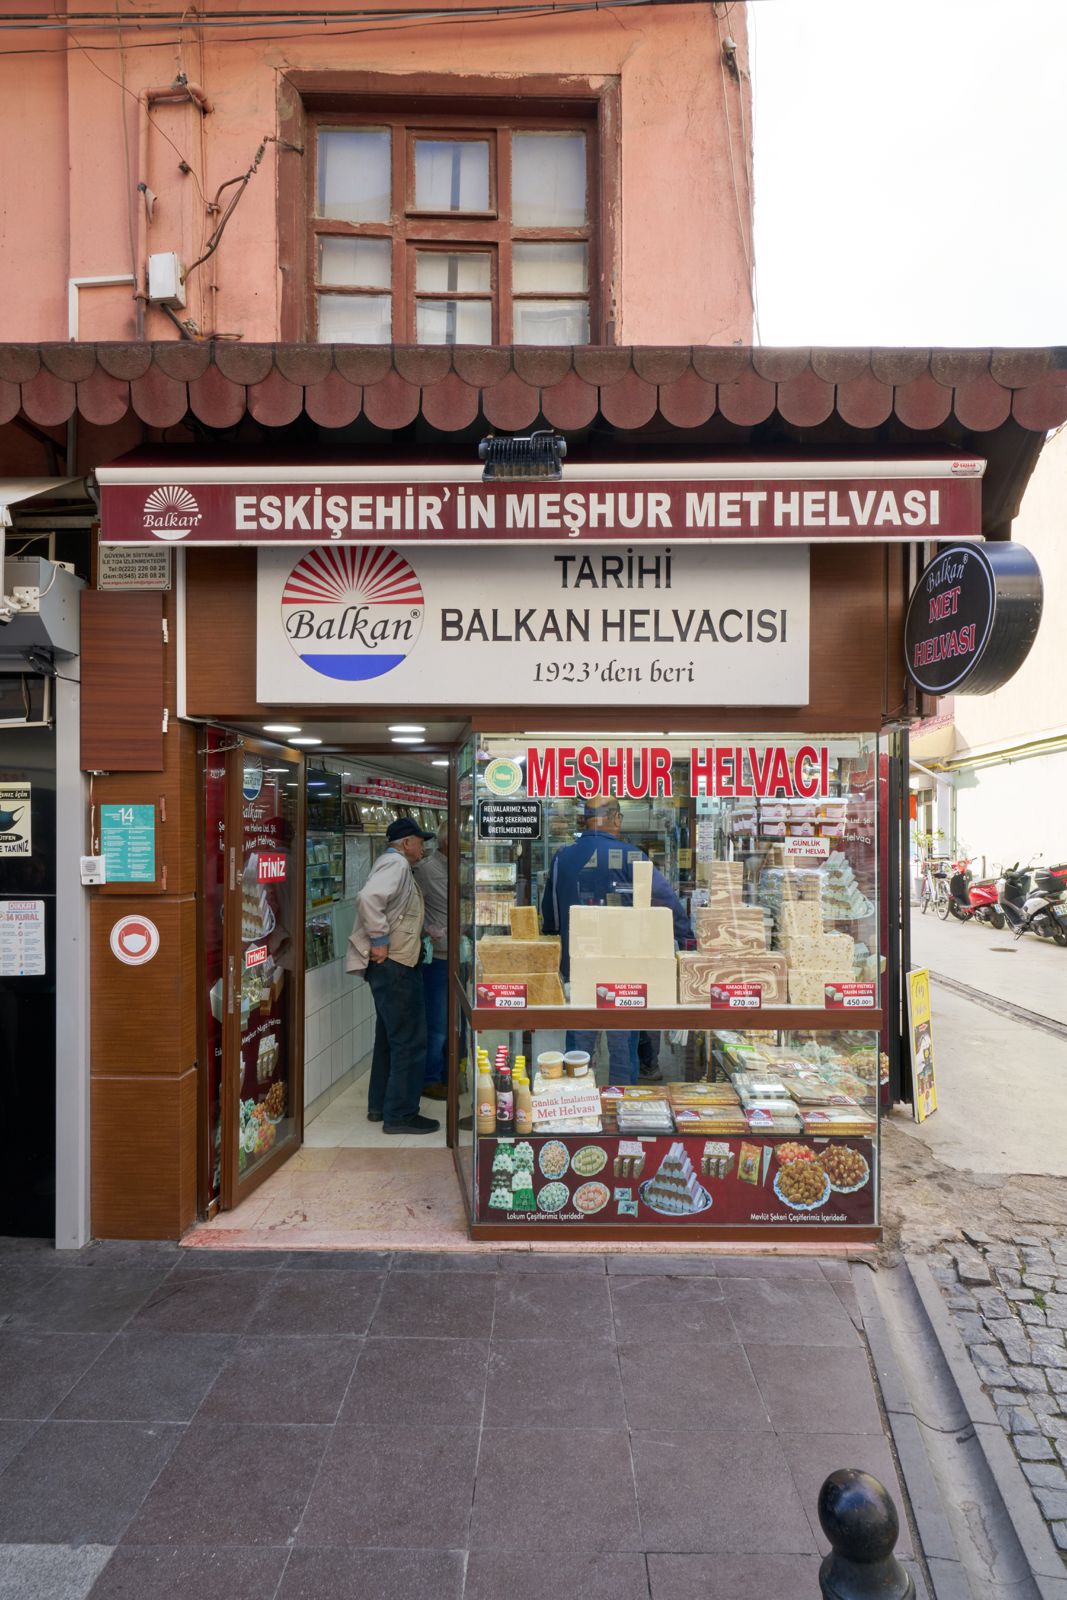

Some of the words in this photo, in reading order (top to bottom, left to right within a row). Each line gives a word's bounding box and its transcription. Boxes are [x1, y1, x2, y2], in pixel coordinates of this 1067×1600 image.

[505, 492, 673, 538] MEŞHUR
[685, 491, 767, 528] MET
[773, 490, 940, 526] HELVASI
[553, 548, 672, 588] TARİHİ
[928, 586, 961, 624] MET
[440, 608, 590, 642] BALKAN
[601, 608, 787, 643] HELVACISI
[913, 623, 976, 668] HELVASI
[532, 659, 643, 683] 1923'den
[649, 659, 695, 683] beri
[689, 745, 829, 799] HELVACI
[118, 807, 135, 823] 14
[483, 805, 521, 813] HELVALARIMIZ
[522, 805, 537, 813] %100
[504, 815, 538, 825] ŞEKERİNDEN
[488, 825, 532, 834] ÜRETİLMEKTEDİR
[792, 838, 821, 847] GÜNLÜK
[805, 847, 826, 855] HELVA
[259, 856, 286, 879] İTİNİZ
[531, 1097, 560, 1108] Günlük
[537, 1108, 557, 1119] Met
[559, 1104, 596, 1116] Helvası
[507, 1212, 526, 1220] Lokum
[526, 1211, 558, 1221] Çeşitlerimiz
[558, 1211, 585, 1221] İçeridedir
[788, 1212, 820, 1222] Çeşitlerimiz
[821, 1212, 848, 1222] İçeridedir
